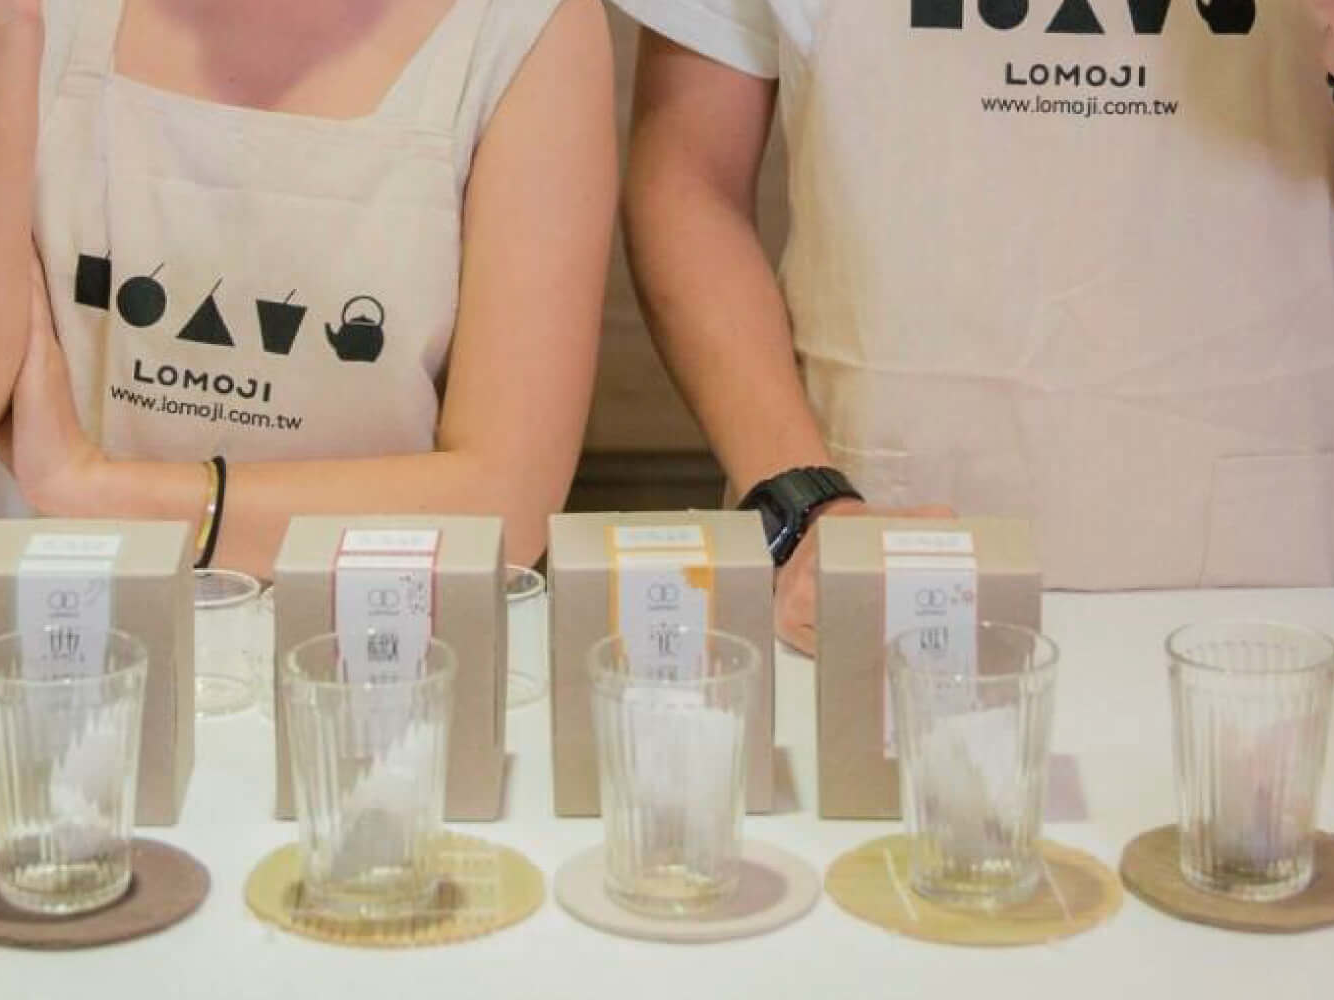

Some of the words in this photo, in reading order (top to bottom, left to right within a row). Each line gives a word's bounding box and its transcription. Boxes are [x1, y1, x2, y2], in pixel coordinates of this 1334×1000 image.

[1005, 62, 1147, 87] LOMOJI
[981, 96, 1179, 118] www.lomoji.com.tw
[133, 358, 272, 403] LOMOJI
[110, 384, 302, 430] www.lomoji.com.tw
